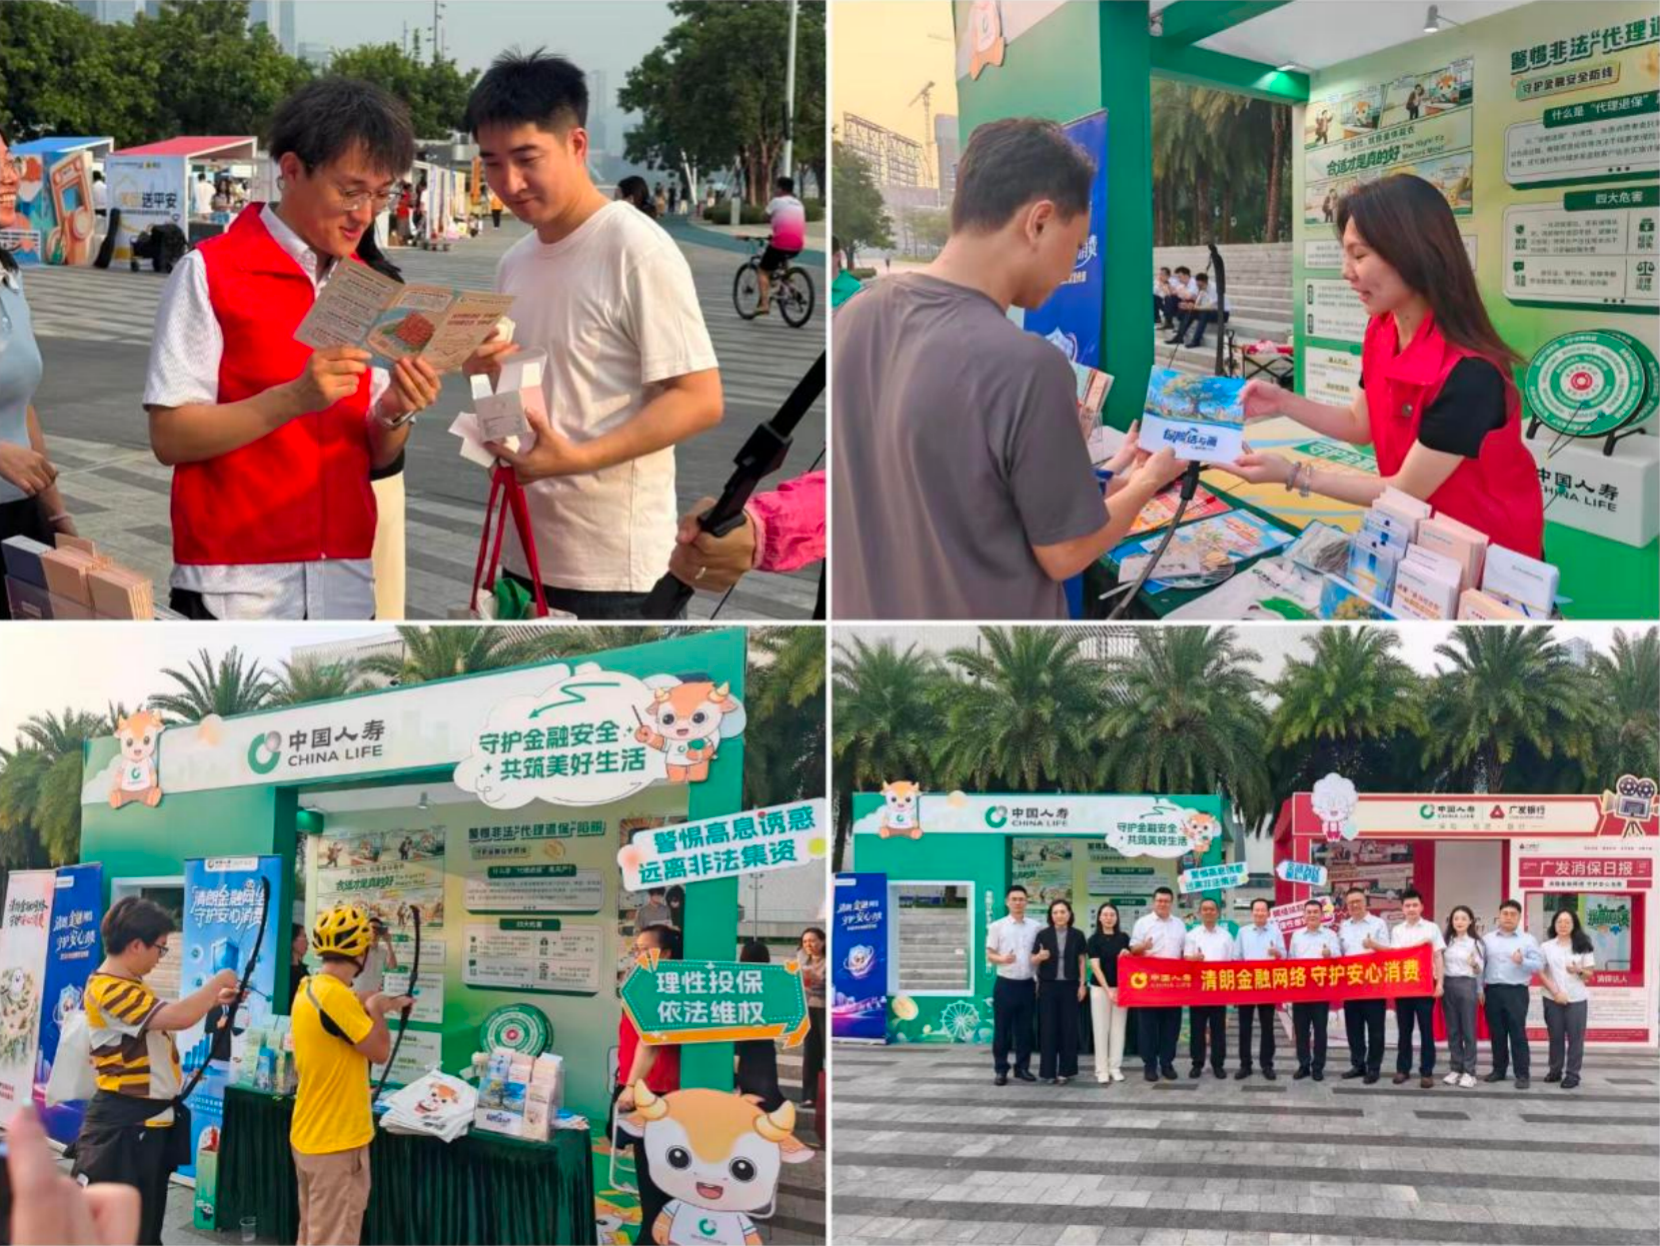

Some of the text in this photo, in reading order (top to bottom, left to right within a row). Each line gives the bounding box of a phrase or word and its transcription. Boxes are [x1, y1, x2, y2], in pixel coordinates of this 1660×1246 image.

[1522, 66, 1613, 94] 守护金融安全防线
[1552, 93, 1660, 120] 什么是“代理退保”
[1326, 144, 1401, 176] 合适才是真的好
[1595, 191, 1643, 204] 四大危害
[1537, 467, 1619, 501] 中国人寿
[1584, 496, 1617, 512] LIFE
[289, 719, 385, 753] 中国人寿
[479, 719, 620, 755] 守护金融安全
[288, 744, 383, 766] CHINA LIFE
[500, 746, 647, 782] 共筑美好生活
[1012, 806, 1069, 819] 中国人寿
[653, 805, 816, 854] 警惕高息诱惑
[1117, 822, 1178, 834] 守护金融安全
[1127, 835, 1188, 847] 共筑美好生活
[638, 838, 798, 884] 远离非法集资
[1540, 860, 1633, 876] 广发消保日报
[656, 970, 763, 995] 理性投保
[1201, 958, 1420, 991] 清朗金融网络 守护安心消费
[657, 1000, 767, 1024] 依法维权
